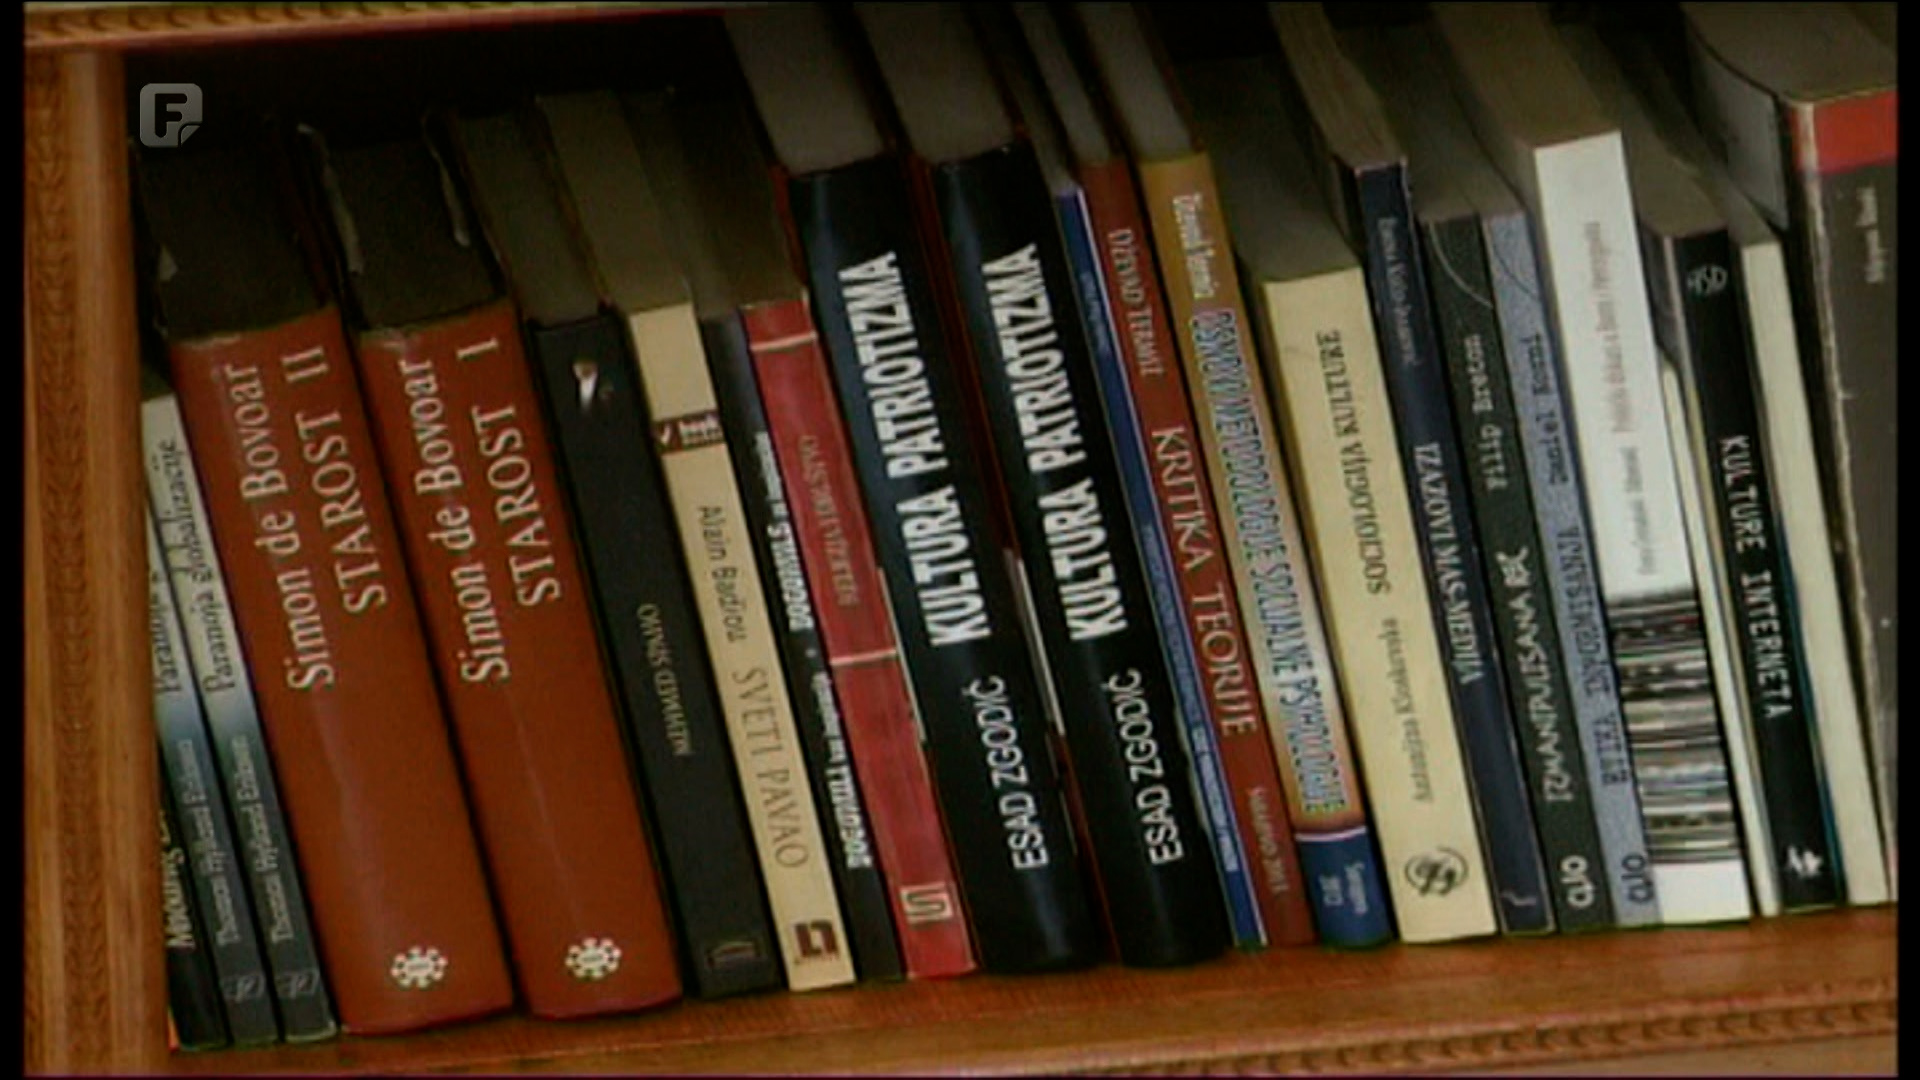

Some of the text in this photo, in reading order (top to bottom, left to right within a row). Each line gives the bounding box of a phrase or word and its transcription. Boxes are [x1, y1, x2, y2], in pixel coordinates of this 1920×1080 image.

[280, 344, 388, 616] STAROST II
[455, 334, 562, 608] STAROST I
[837, 250, 992, 647] KULTURA PATRIOTIZMA
[981, 242, 1129, 642] KULTURA PATRIOTIZMA
[1315, 326, 1392, 597] SOCIOLOGIJA KULTURE
[1415, 443, 1457, 540] IZAZOVI
[1463, 333, 1495, 414] Breton
[152, 438, 235, 692] Paranoja globalizacije
[223, 362, 336, 691] Simon de Bovoar
[396, 356, 511, 686] Simon de Bovoar
[697, 504, 748, 643] Alain Badiou
[1151, 426, 1213, 571] KRITIKA
[1192, 583, 1259, 738] TEORIJE
[1720, 434, 1792, 720] KULTURE INTERNETA
[731, 666, 811, 870] SVETI PAVAO
[962, 674, 1050, 870] ESAD ZGODIĆ
[1101, 667, 1165, 783] ZGODIĆ
[1135, 786, 1184, 867] ESAD
